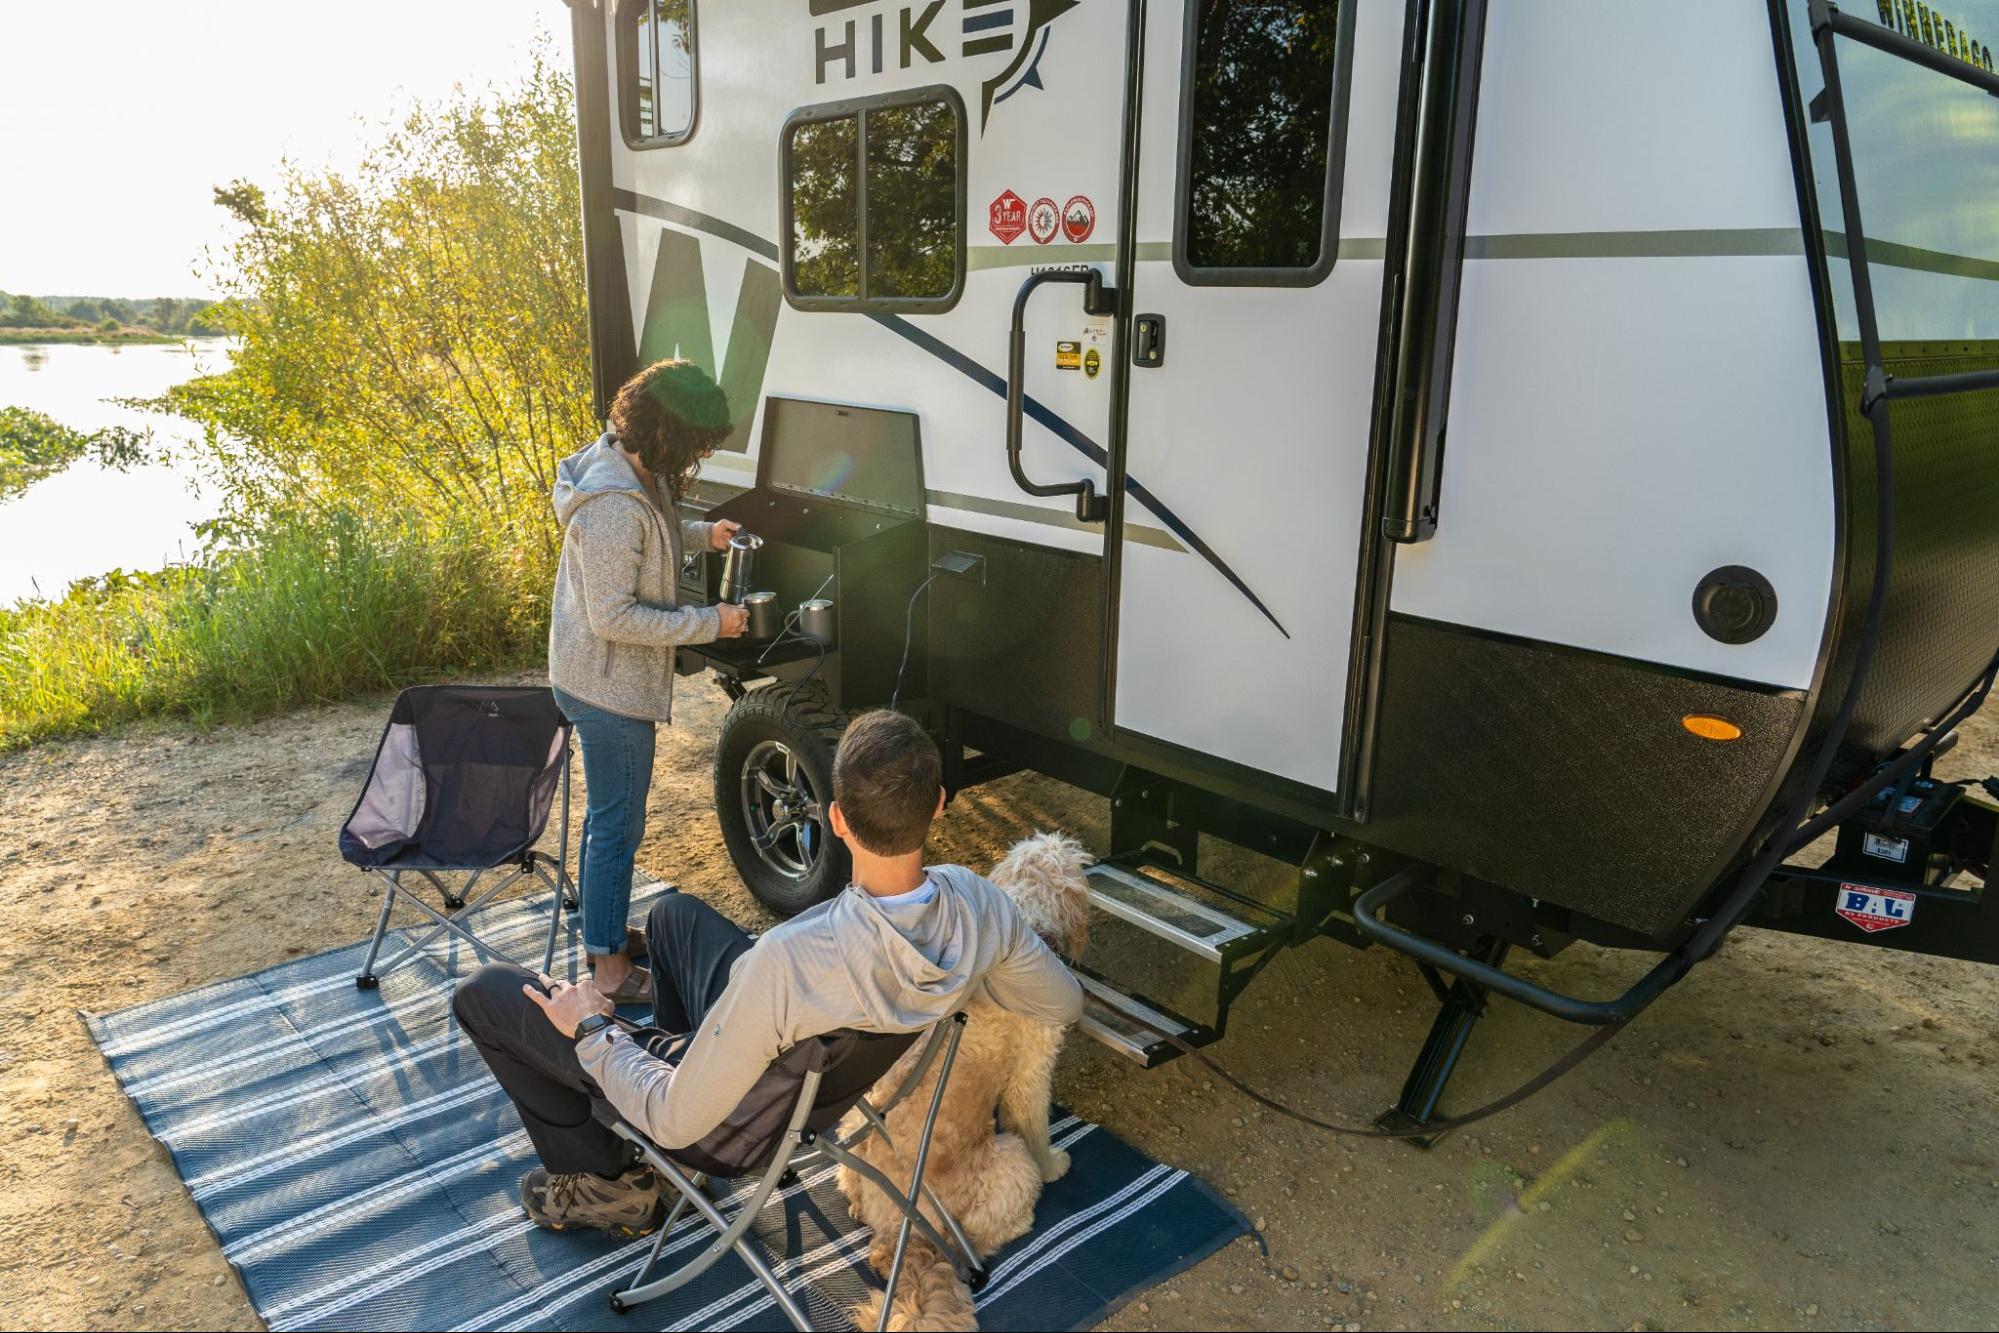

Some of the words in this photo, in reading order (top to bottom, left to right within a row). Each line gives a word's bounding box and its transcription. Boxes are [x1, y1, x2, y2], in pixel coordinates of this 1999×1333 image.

[815, 0, 1013, 84] HIKE
[994, 204, 1002, 225] 3
[1002, 210, 1021, 222] YEAR
[1845, 892, 1904, 917] BAL
